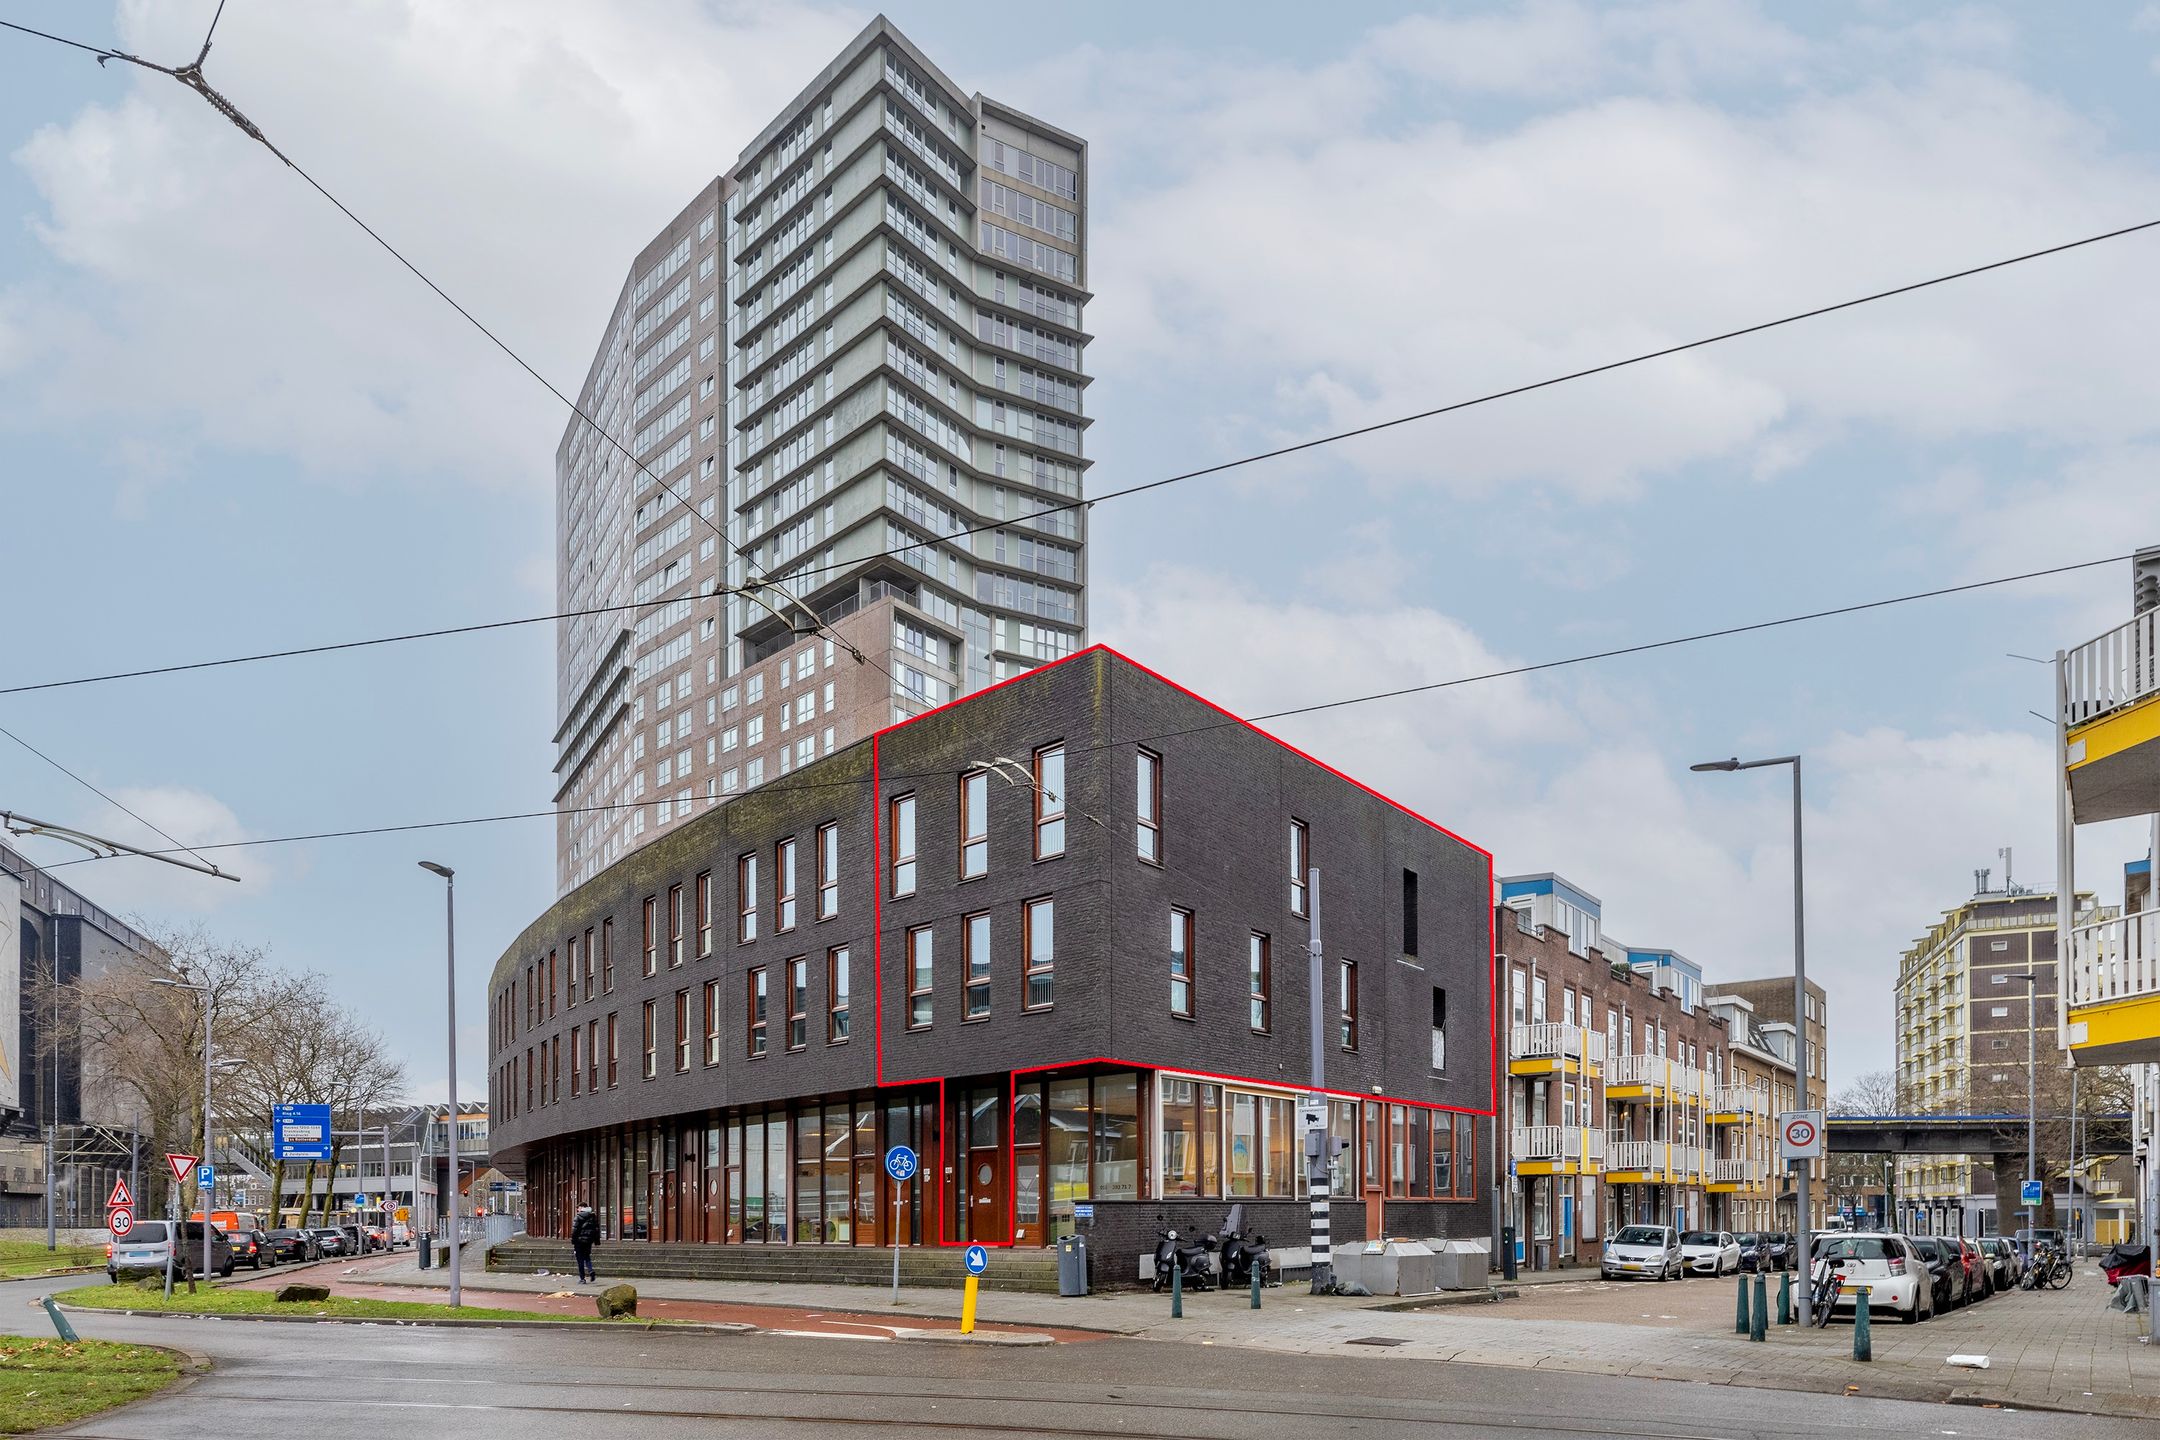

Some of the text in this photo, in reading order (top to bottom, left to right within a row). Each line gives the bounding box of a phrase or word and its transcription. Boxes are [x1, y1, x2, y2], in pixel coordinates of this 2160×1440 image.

[1792, 1128, 1810, 1139] 30
[201, 1168, 210, 1179] P
[115, 1217, 129, 1228] 30
